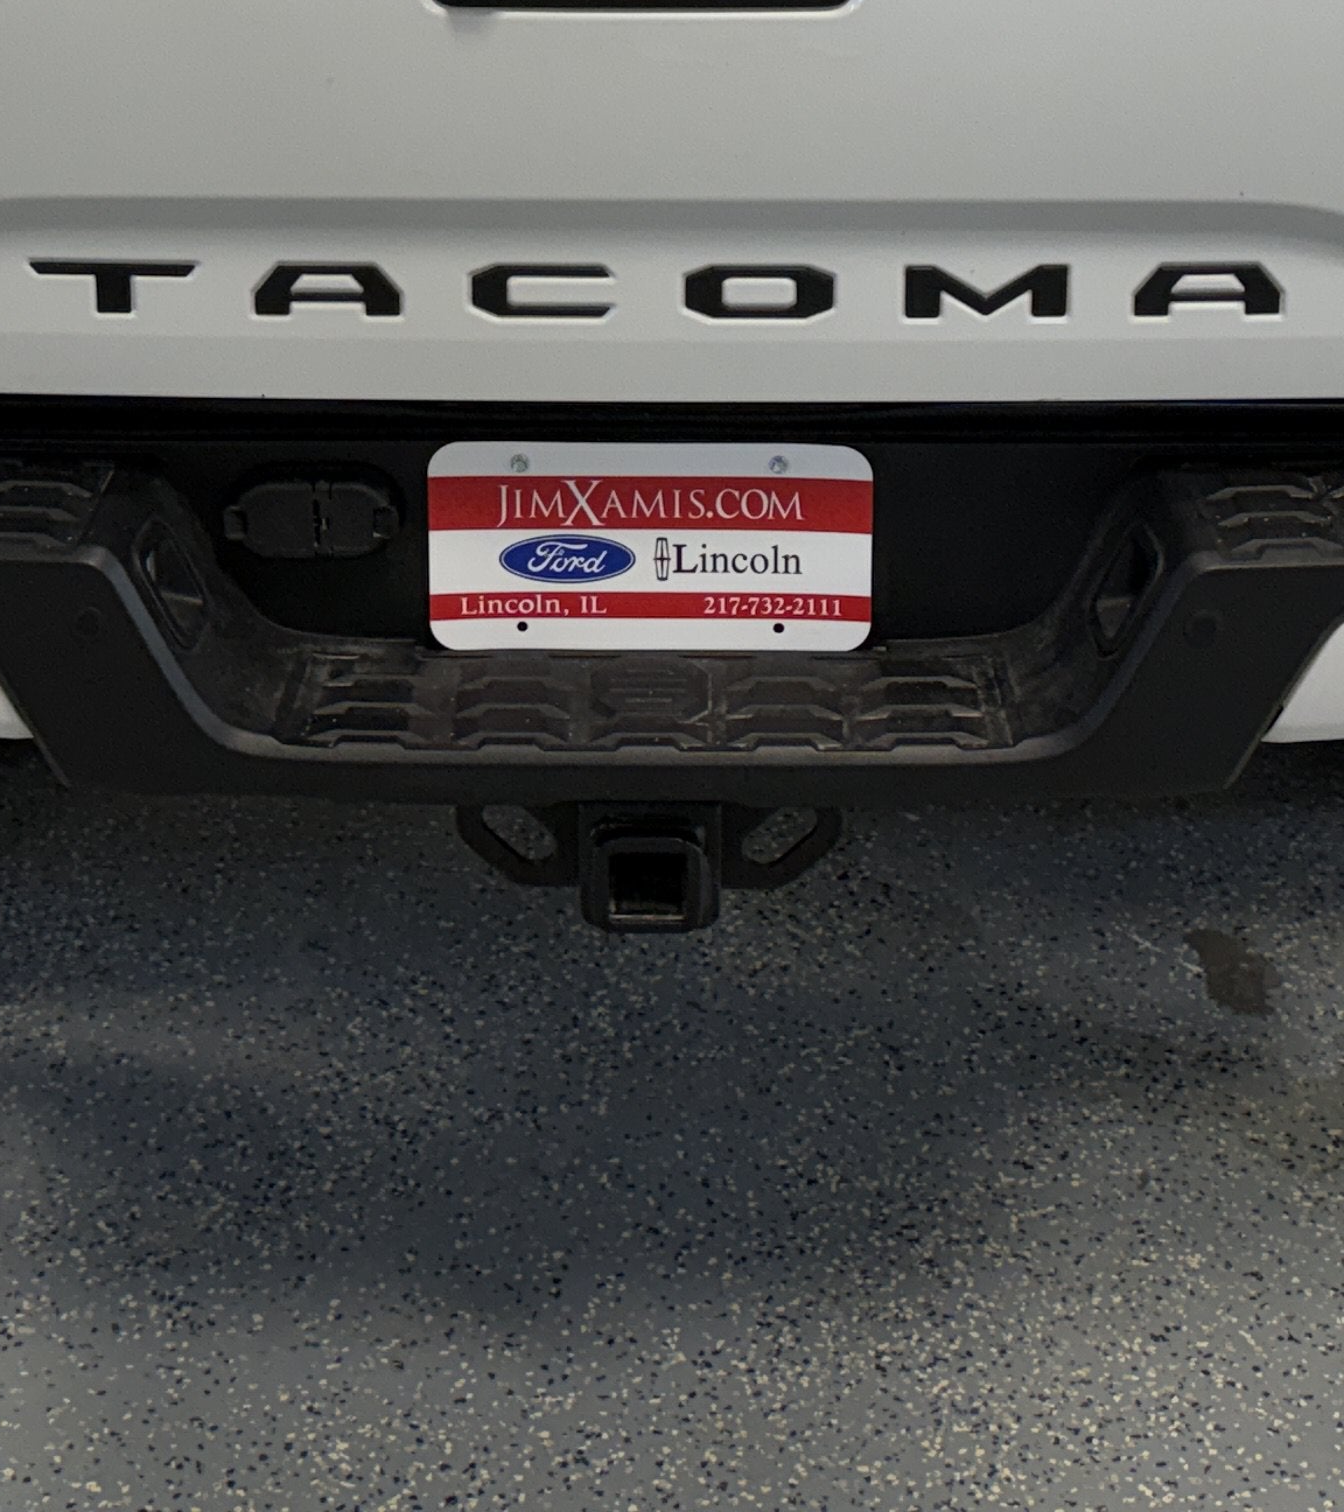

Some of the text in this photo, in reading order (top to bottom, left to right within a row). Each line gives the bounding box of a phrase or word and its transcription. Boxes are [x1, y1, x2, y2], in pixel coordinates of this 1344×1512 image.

[29, 258, 1285, 319] TACOMA
[496, 479, 805, 527] JIMXAMIS.COM
[527, 540, 607, 575] Ford
[672, 544, 803, 575] Lincoln
[460, 595, 608, 617] Lincoln, IL
[703, 596, 843, 617] 217-732-2111
